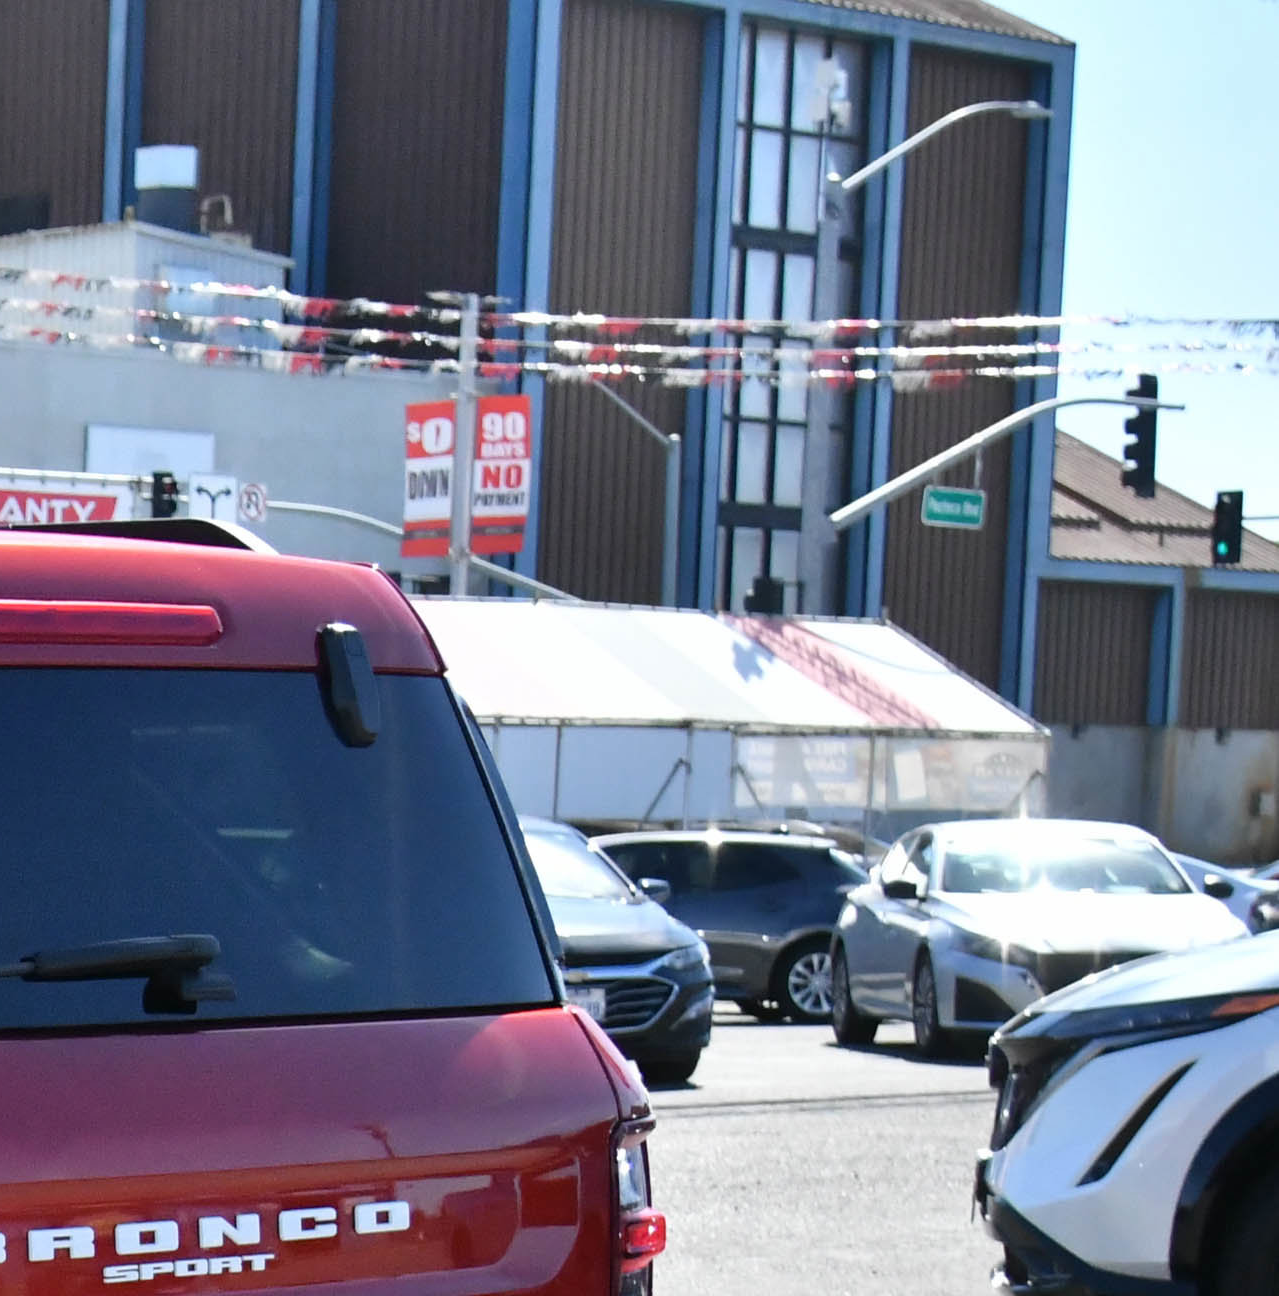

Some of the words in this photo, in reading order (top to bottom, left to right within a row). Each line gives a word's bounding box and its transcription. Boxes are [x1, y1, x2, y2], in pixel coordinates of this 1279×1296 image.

[407, 417, 454, 455] $0
[482, 412, 526, 441] 90
[481, 442, 525, 458] DAYS
[408, 469, 450, 500] DOWN
[482, 464, 523, 489] NO
[473, 491, 526, 506] PAYMENT
[102, 1253, 275, 1284] SPORT
